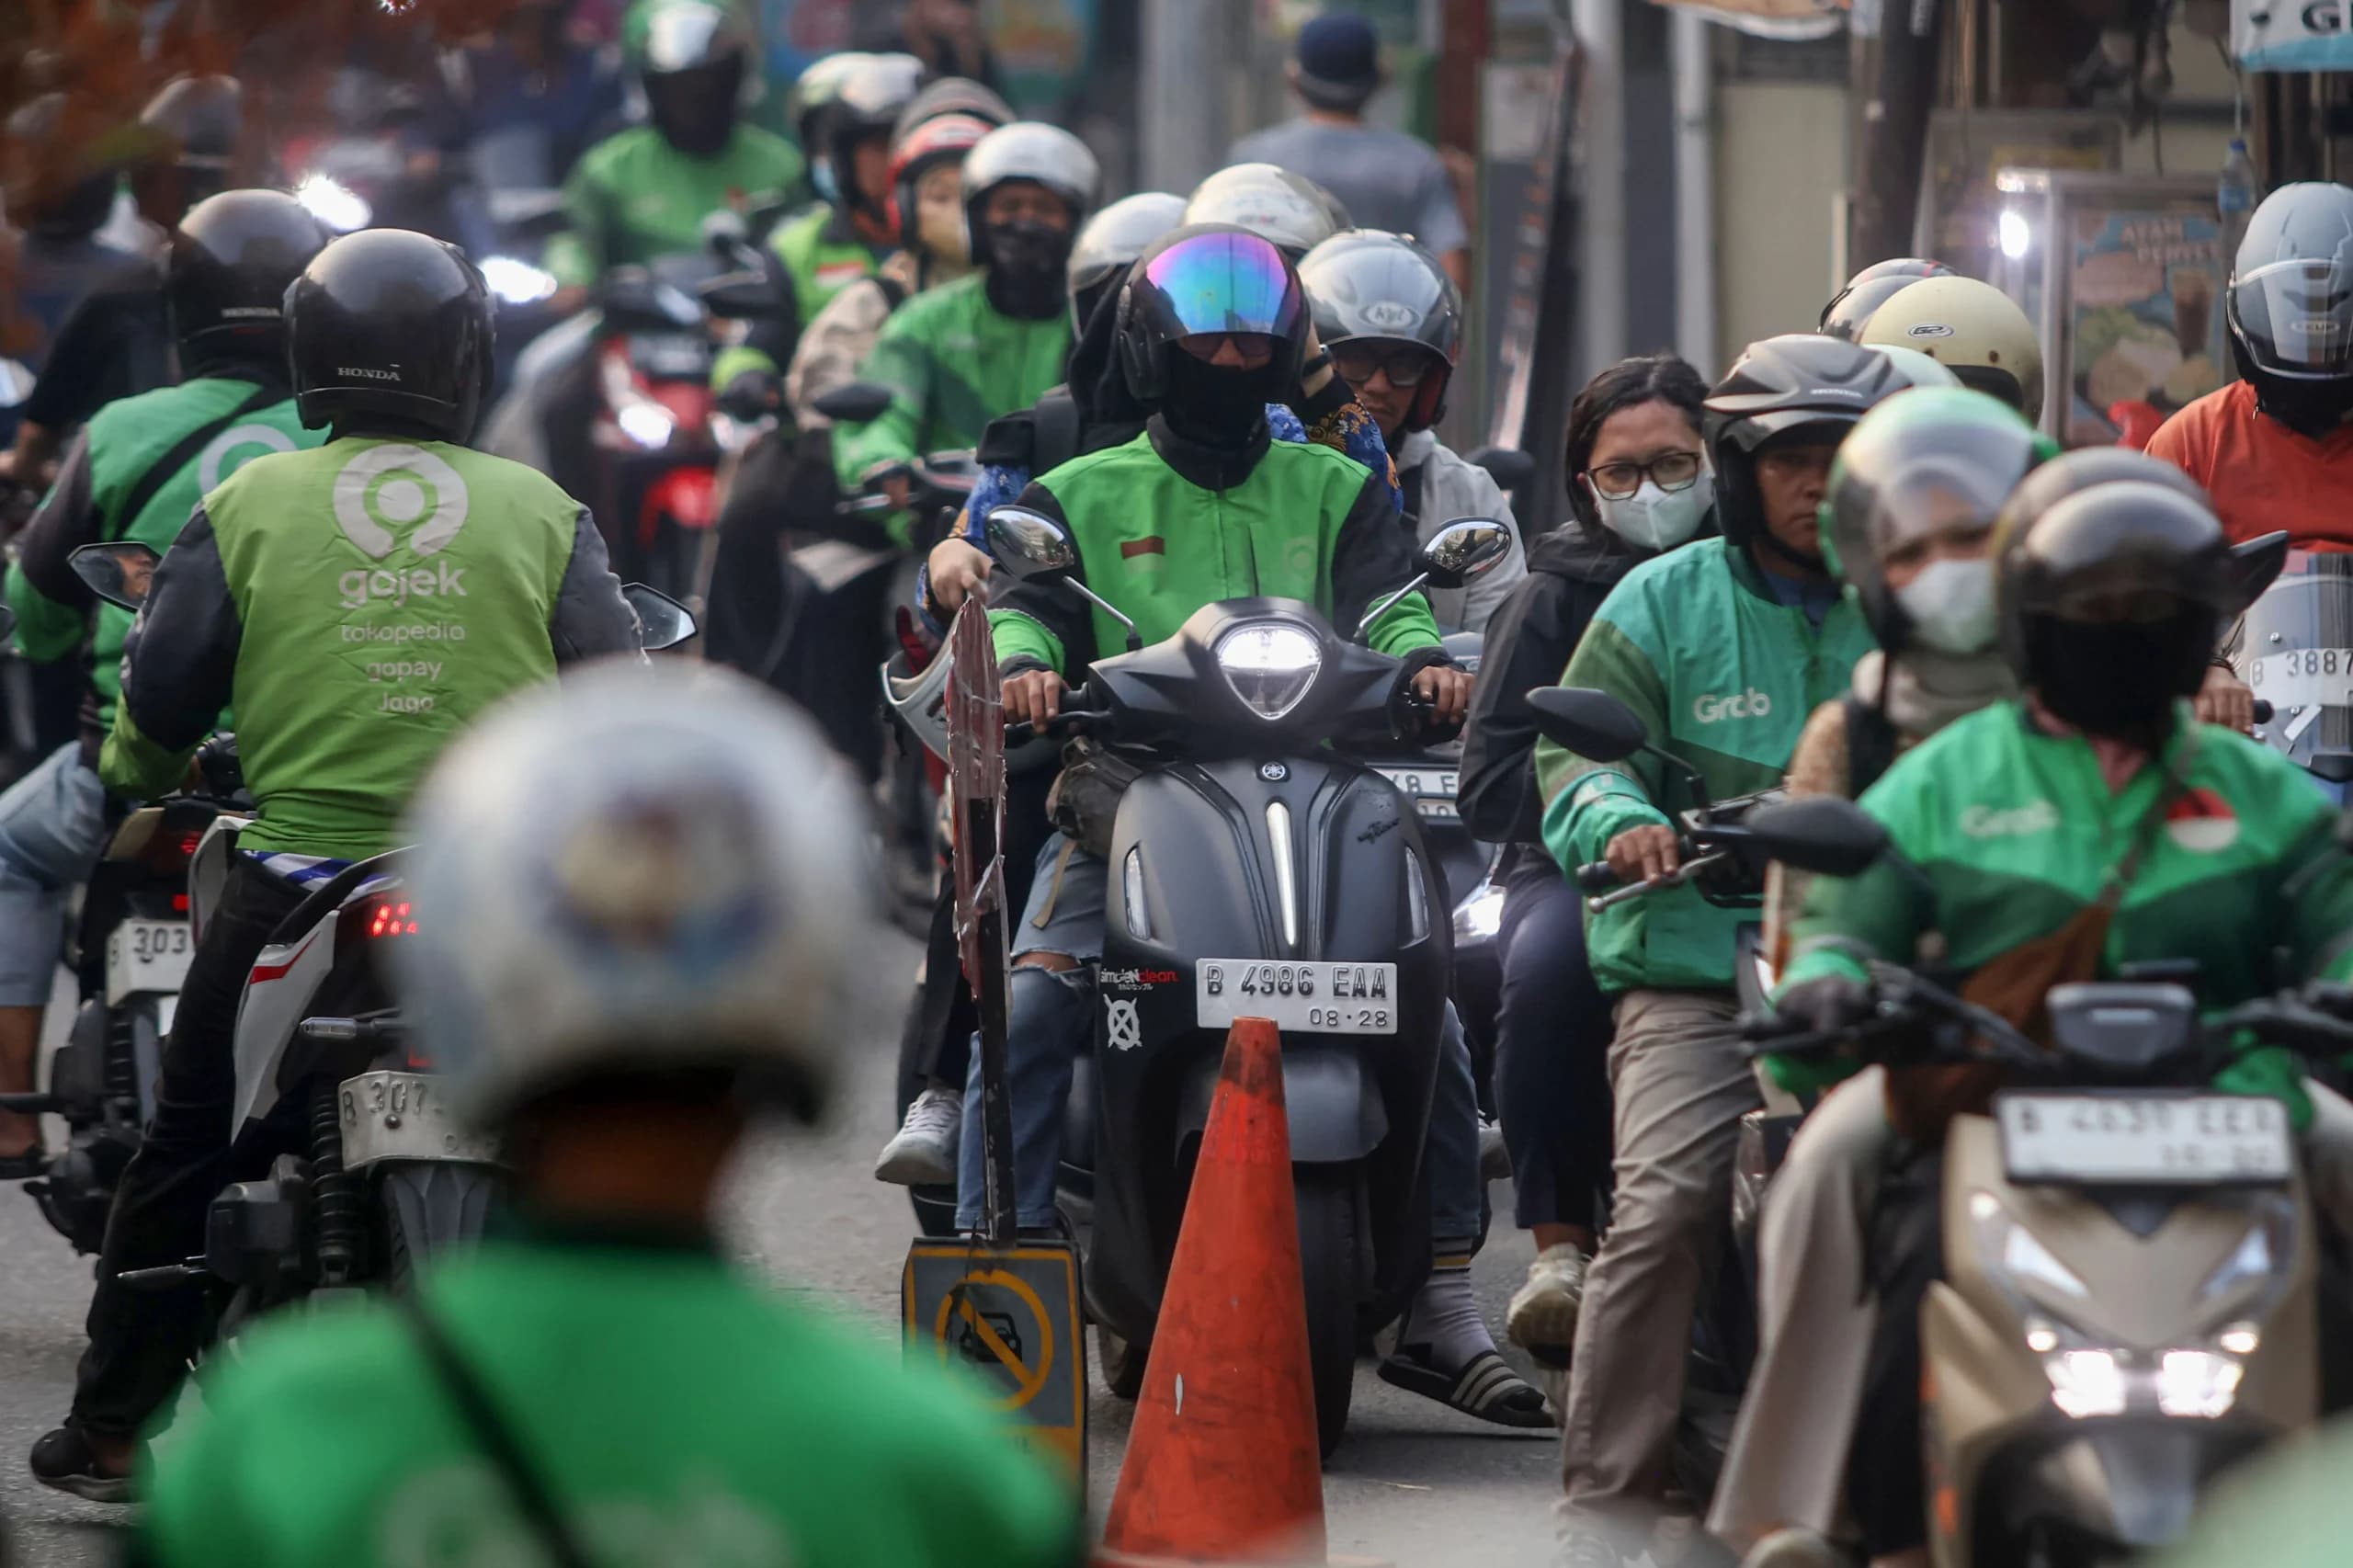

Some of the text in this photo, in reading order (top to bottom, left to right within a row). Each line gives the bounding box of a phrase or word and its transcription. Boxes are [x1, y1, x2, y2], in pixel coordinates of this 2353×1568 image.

[338, 368, 401, 381] HONDA
[338, 560, 468, 608] gojek
[341, 621, 466, 645] tokopedia
[368, 661, 443, 682] gopay
[2285, 649, 2353, 676] 3887
[1693, 687, 1772, 723] Grab
[1206, 964, 1387, 999] B 4986 EAA
